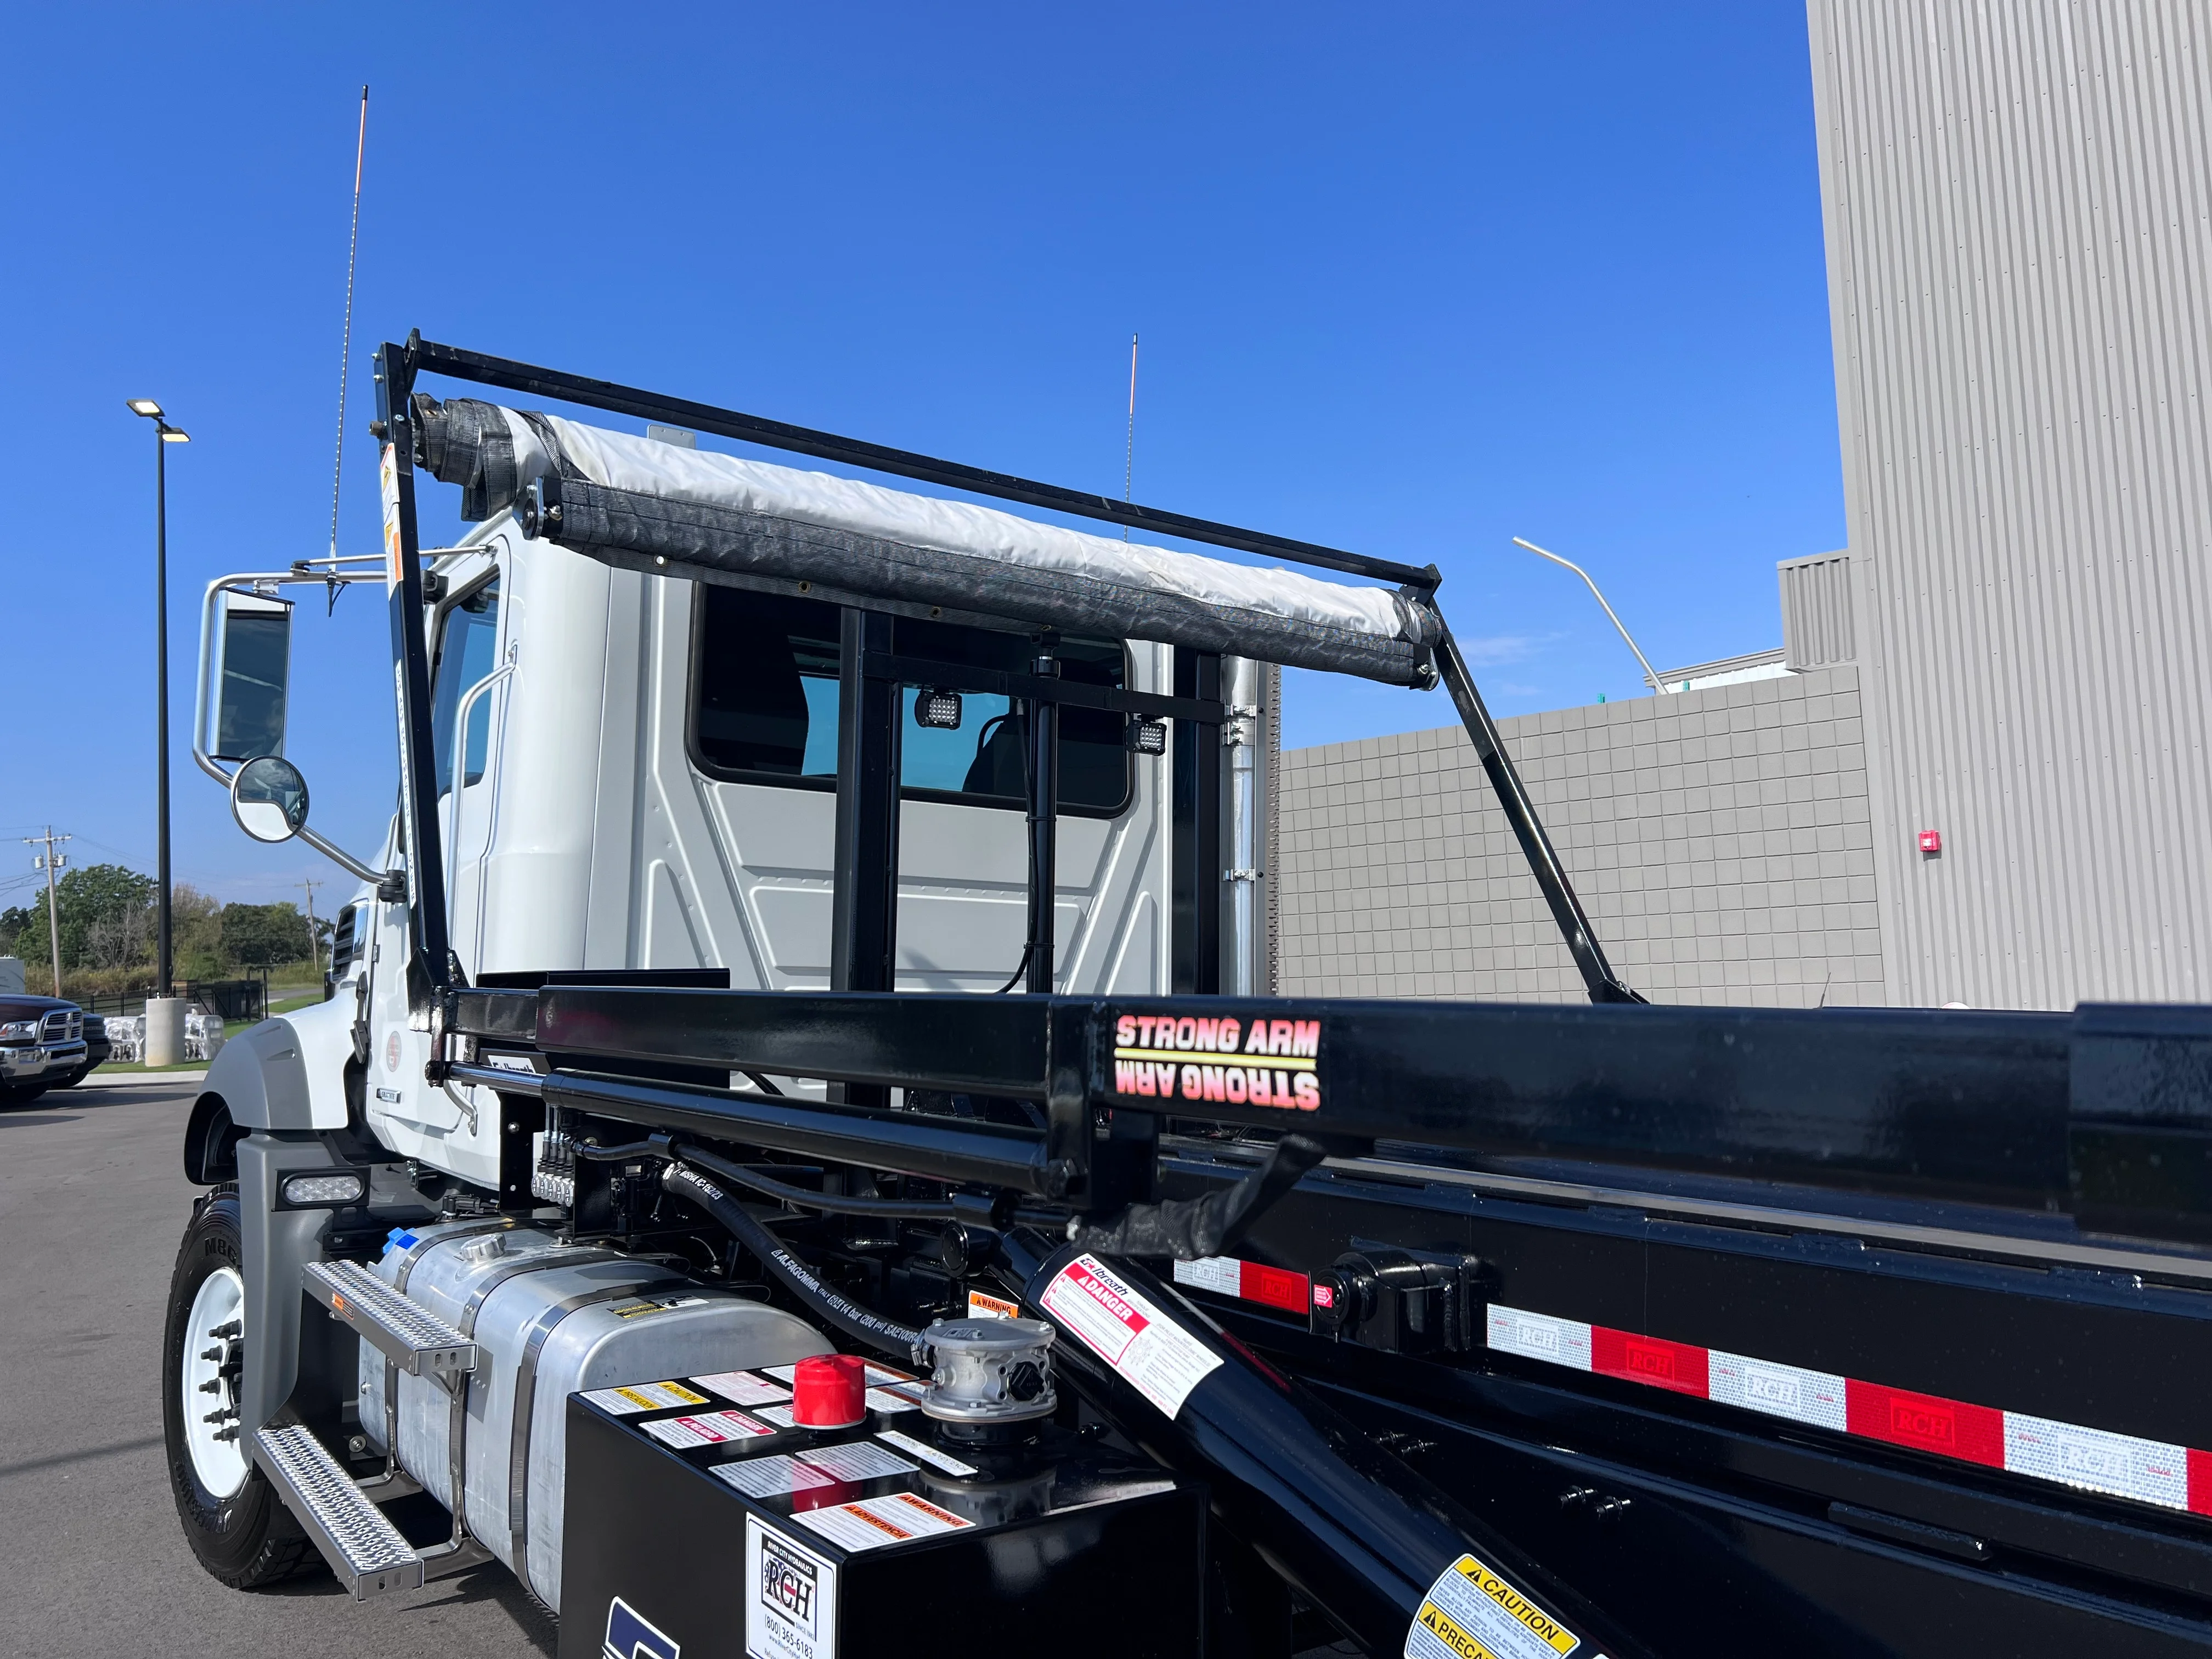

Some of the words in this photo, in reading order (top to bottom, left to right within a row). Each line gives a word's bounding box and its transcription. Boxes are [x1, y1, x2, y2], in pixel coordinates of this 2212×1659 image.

[1116, 1015, 1240, 1052] STRONG
[1244, 1020, 1321, 1057] ARM
[679, 1171, 700, 1183] MSHA
[776, 1254, 820, 1293] ALFAGOMMA
[817, 1288, 831, 1299] ITALY
[840, 1304, 852, 1314] 14
[847, 1307, 862, 1321] bar
[859, 1314, 877, 1328] (200
[983, 1298, 1011, 1314] WARNING
[1085, 1277, 1135, 1321] DANGER
[1265, 1280, 1288, 1298] RCH
[1632, 1351, 1670, 1374] RCH
[1898, 1409, 1949, 1437] RCH
[854, 1509, 908, 1538] ADVERTENCIA
[909, 1497, 963, 1526] WARNING
[768, 1541, 780, 1554] RIVER
[779, 1548, 789, 1560] CITY
[788, 1554, 812, 1576] HYDRAULICS
[766, 1559, 812, 1623] RCH
[1483, 1579, 1560, 1641] CAUTION
[764, 1613, 781, 1638] (800)
[782, 1627, 812, 1659] 365-6183
[1438, 1621, 1488, 1659] PRECA
